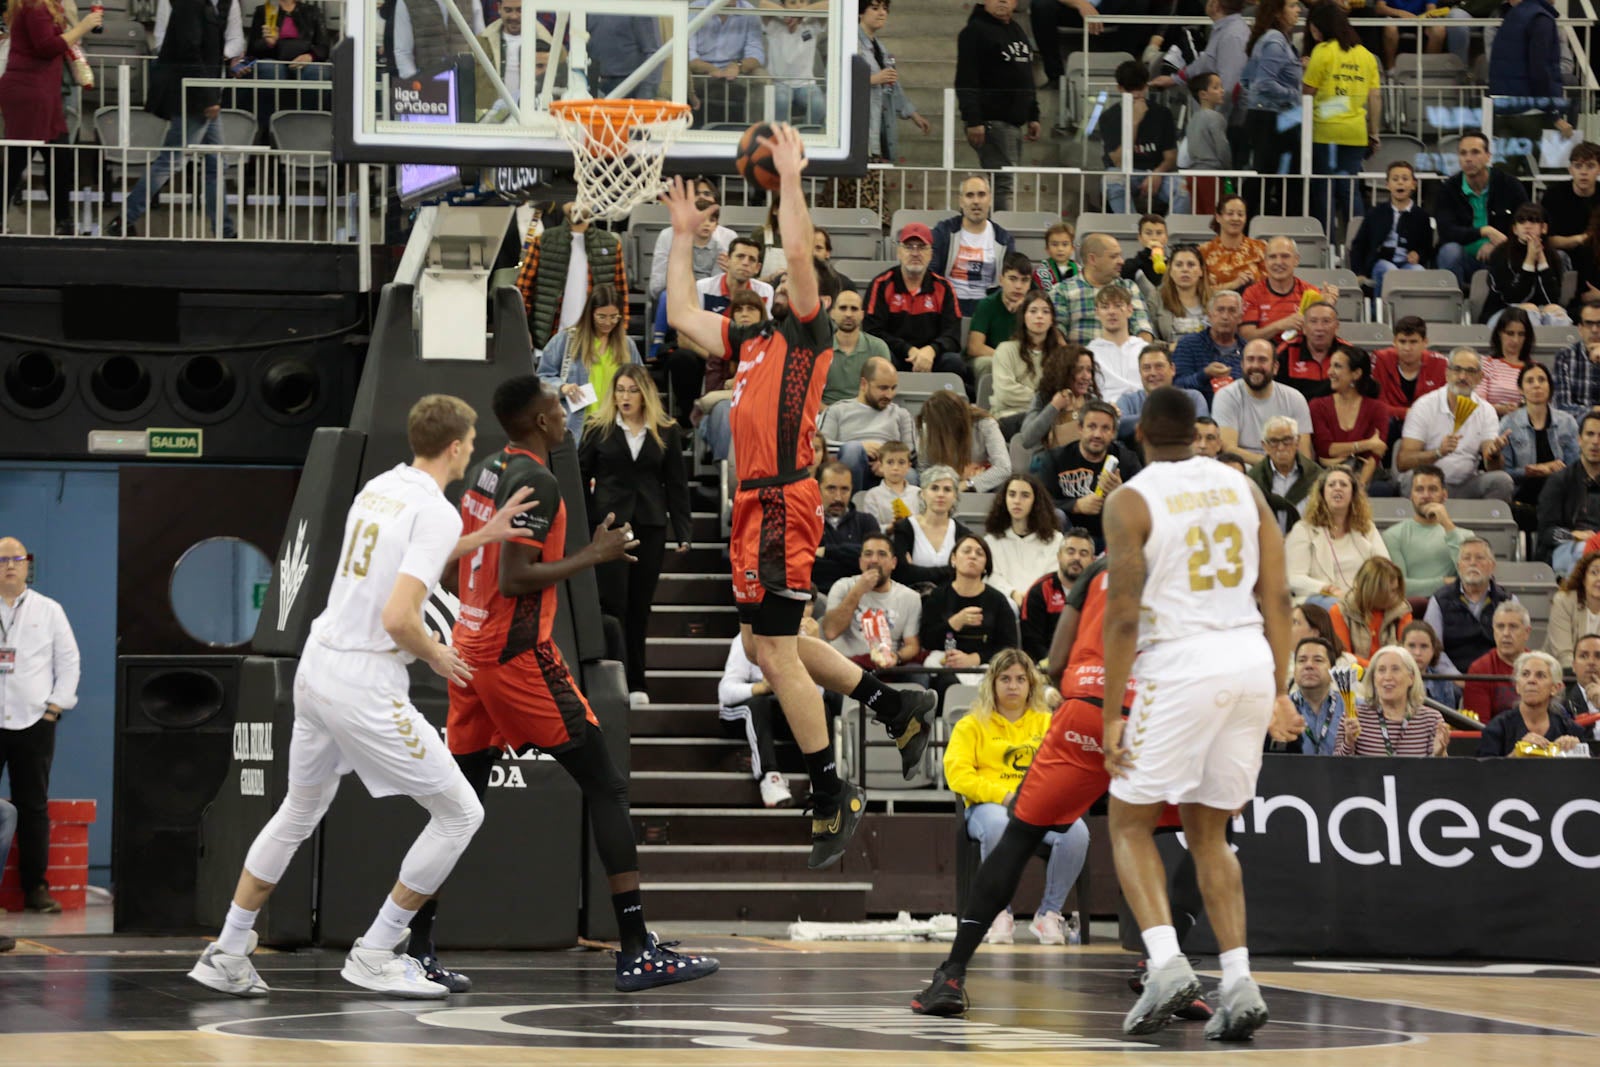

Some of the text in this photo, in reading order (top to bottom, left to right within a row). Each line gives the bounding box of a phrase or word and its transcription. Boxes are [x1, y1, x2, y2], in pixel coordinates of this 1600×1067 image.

[394, 86, 420, 102] liga
[394, 100, 448, 114] endesa
[151, 435, 197, 449] SALIDA
[341, 518, 380, 580] 13
[1184, 522, 1244, 592] 23
[1064, 730, 1098, 747] CAJA
